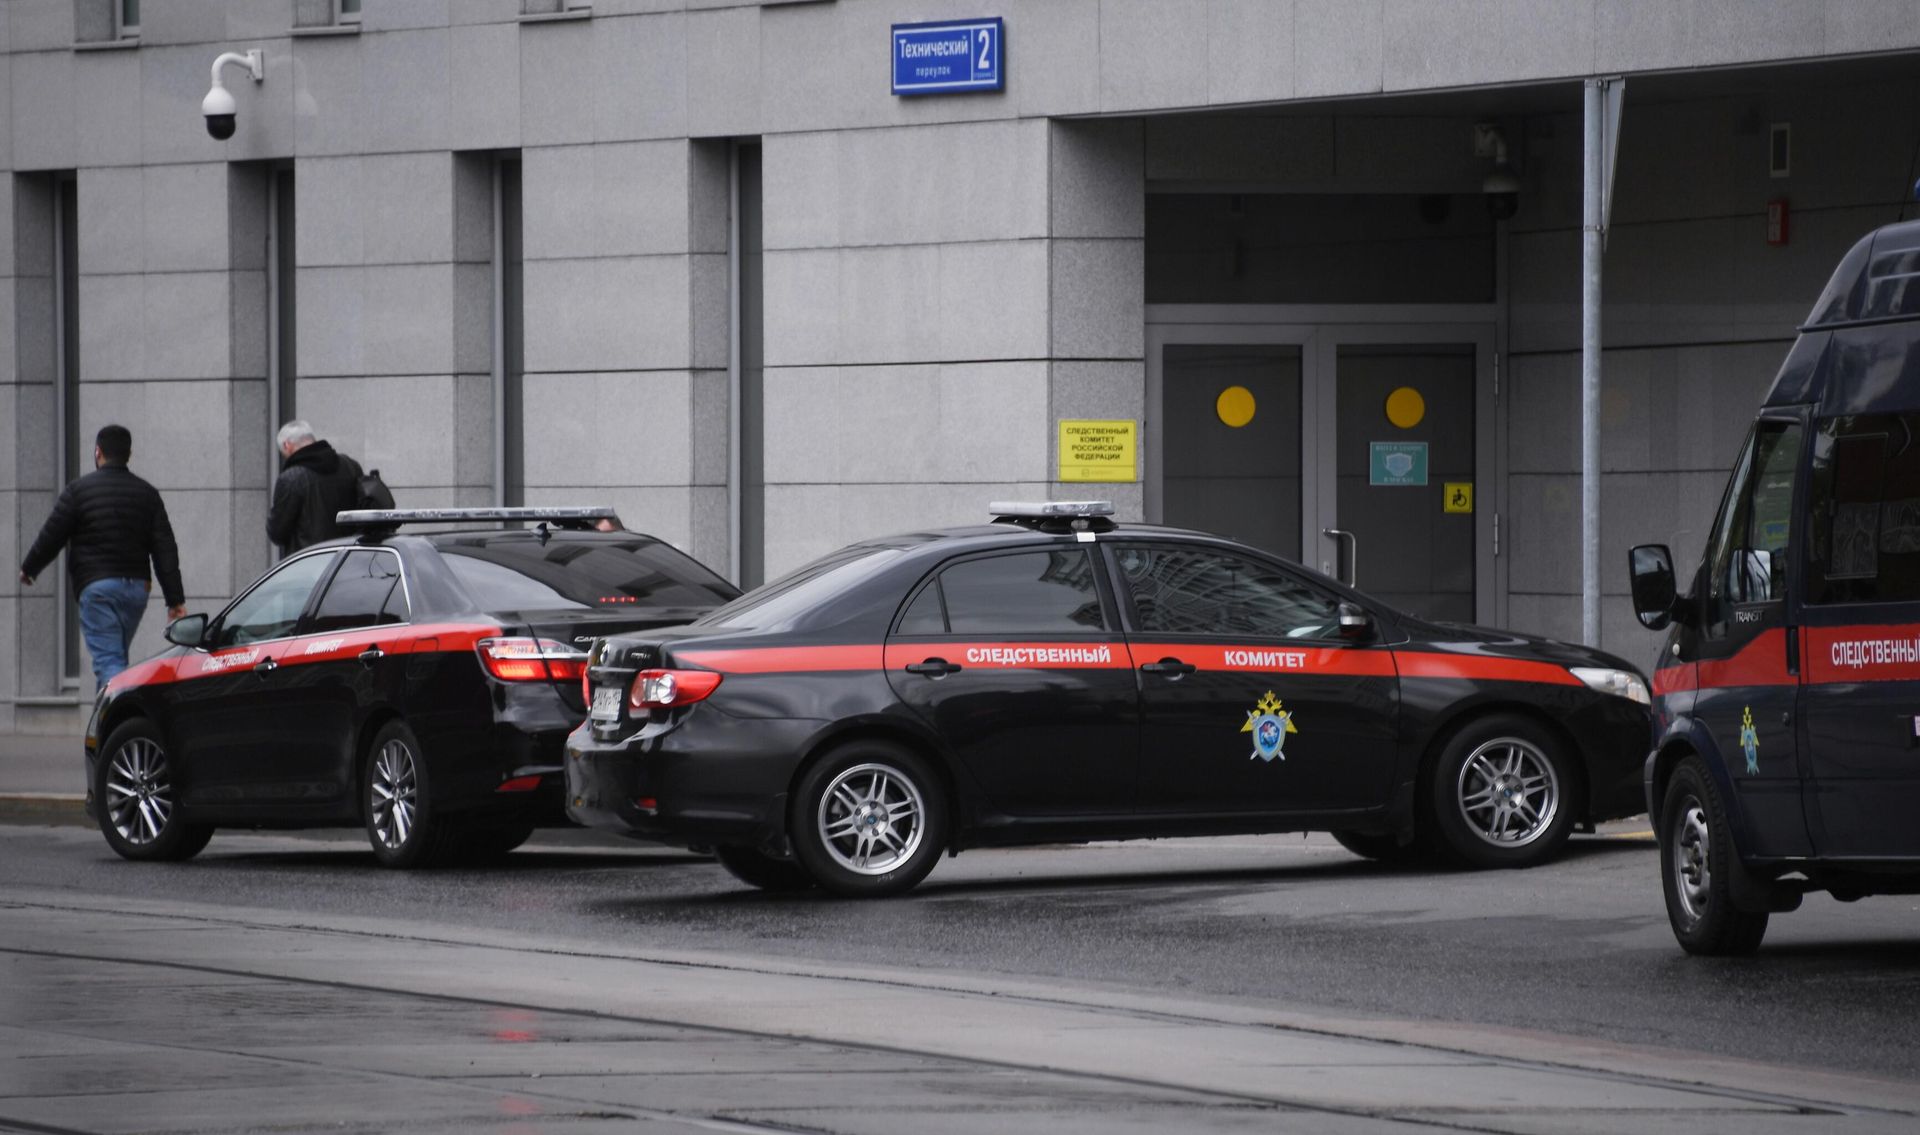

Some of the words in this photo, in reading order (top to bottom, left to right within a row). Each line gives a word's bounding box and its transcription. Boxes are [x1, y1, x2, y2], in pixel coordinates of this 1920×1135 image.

[898, 35, 969, 58] Технический
[978, 29, 990, 69] 2
[915, 66, 951, 78] переулок
[1066, 427, 1129, 435] СЛЕДСТВЕННЫЙ
[1072, 444, 1124, 452] РОССИЙСКОЙ
[1075, 453, 1121, 461] ФЕДЕРАЦИИ
[1735, 610, 1764, 623] TRANSIT
[966, 646, 1112, 665] СЛЕДСТВЕННЫЙ
[1224, 650, 1307, 668] КОМИТЕТ
[1831, 636, 1920, 669] СЛЕДСТВЕННЫ
